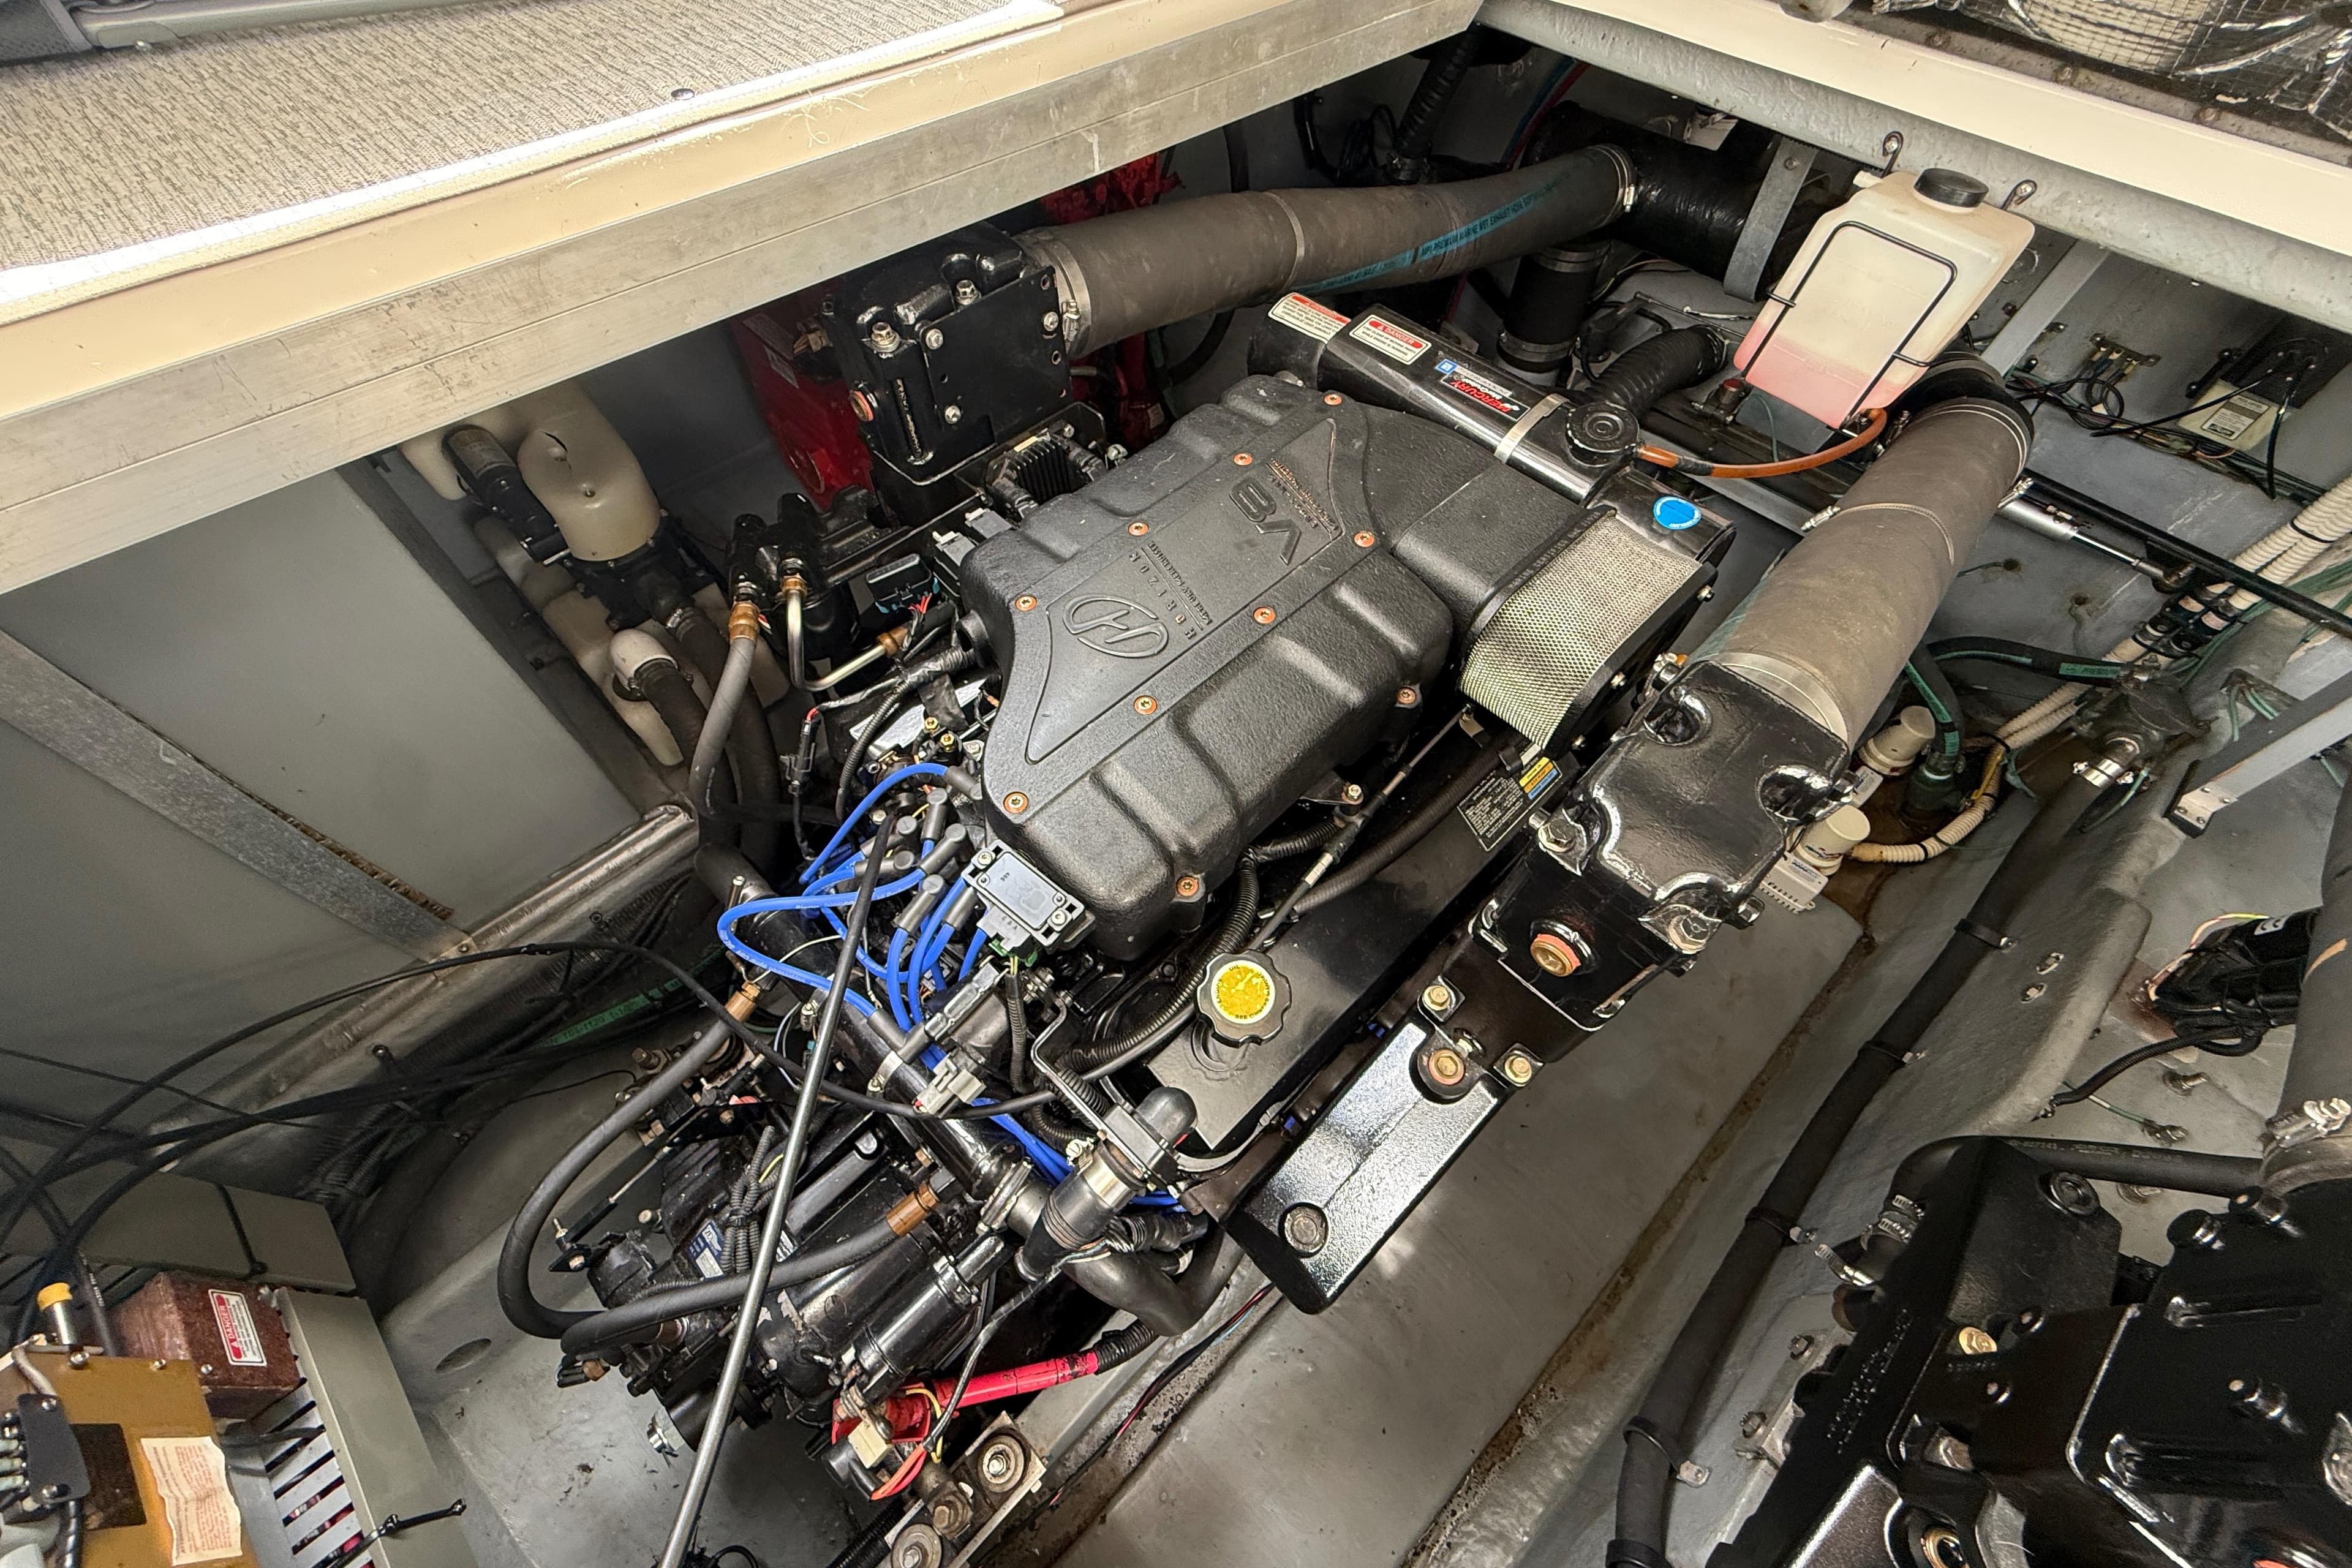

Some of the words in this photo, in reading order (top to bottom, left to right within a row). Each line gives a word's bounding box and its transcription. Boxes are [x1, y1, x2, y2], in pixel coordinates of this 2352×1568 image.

[1384, 327, 1414, 345] DANGER
[1449, 377, 1511, 414] MERCURY
[1227, 479, 1301, 565] V8
[1127, 549, 1197, 641] HORIZON
[219, 1305, 236, 1338] DANGER
